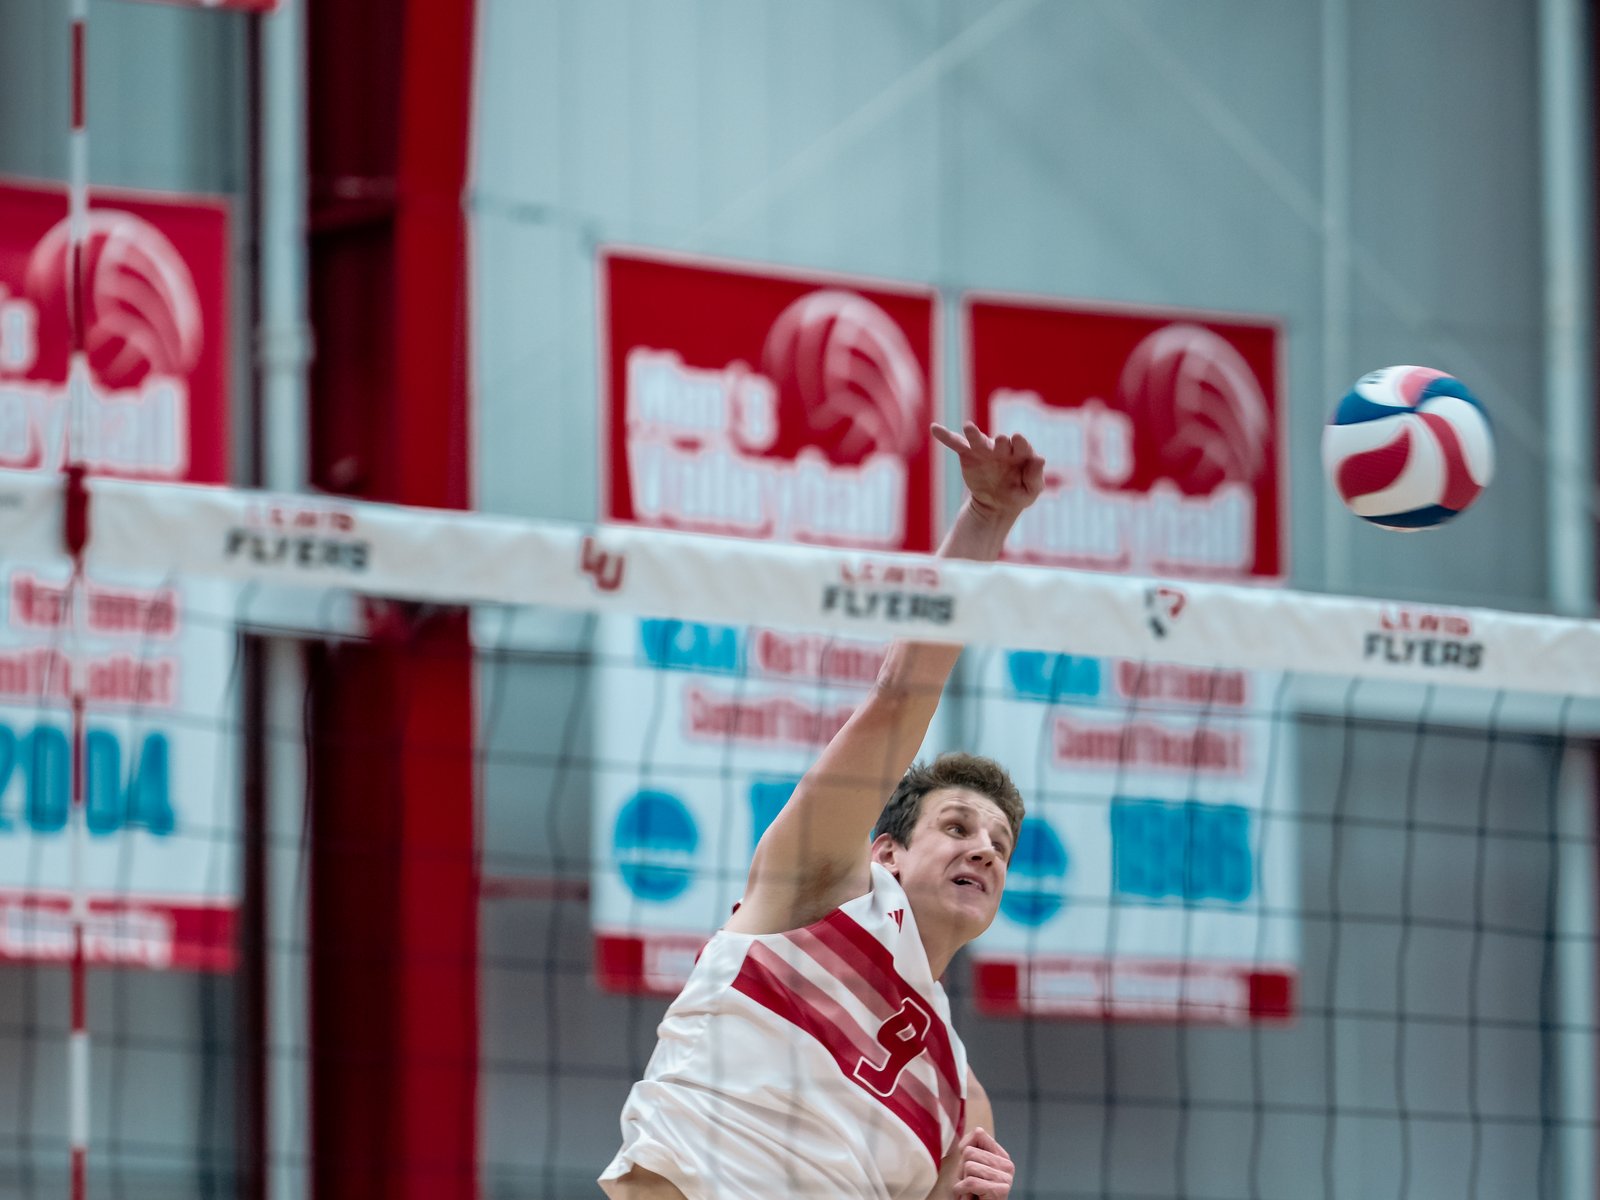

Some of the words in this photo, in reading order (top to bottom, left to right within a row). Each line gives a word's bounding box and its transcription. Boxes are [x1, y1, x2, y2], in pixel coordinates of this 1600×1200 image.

[226, 526, 371, 573] FLYERS
[1002, 476, 1253, 576] olleyball
[580, 535, 626, 592] LU
[821, 585, 955, 626] FLYERS
[1380, 608, 1471, 637] LEWIS
[1364, 632, 1485, 672] FLYERS
[853, 997, 931, 1097] 9
